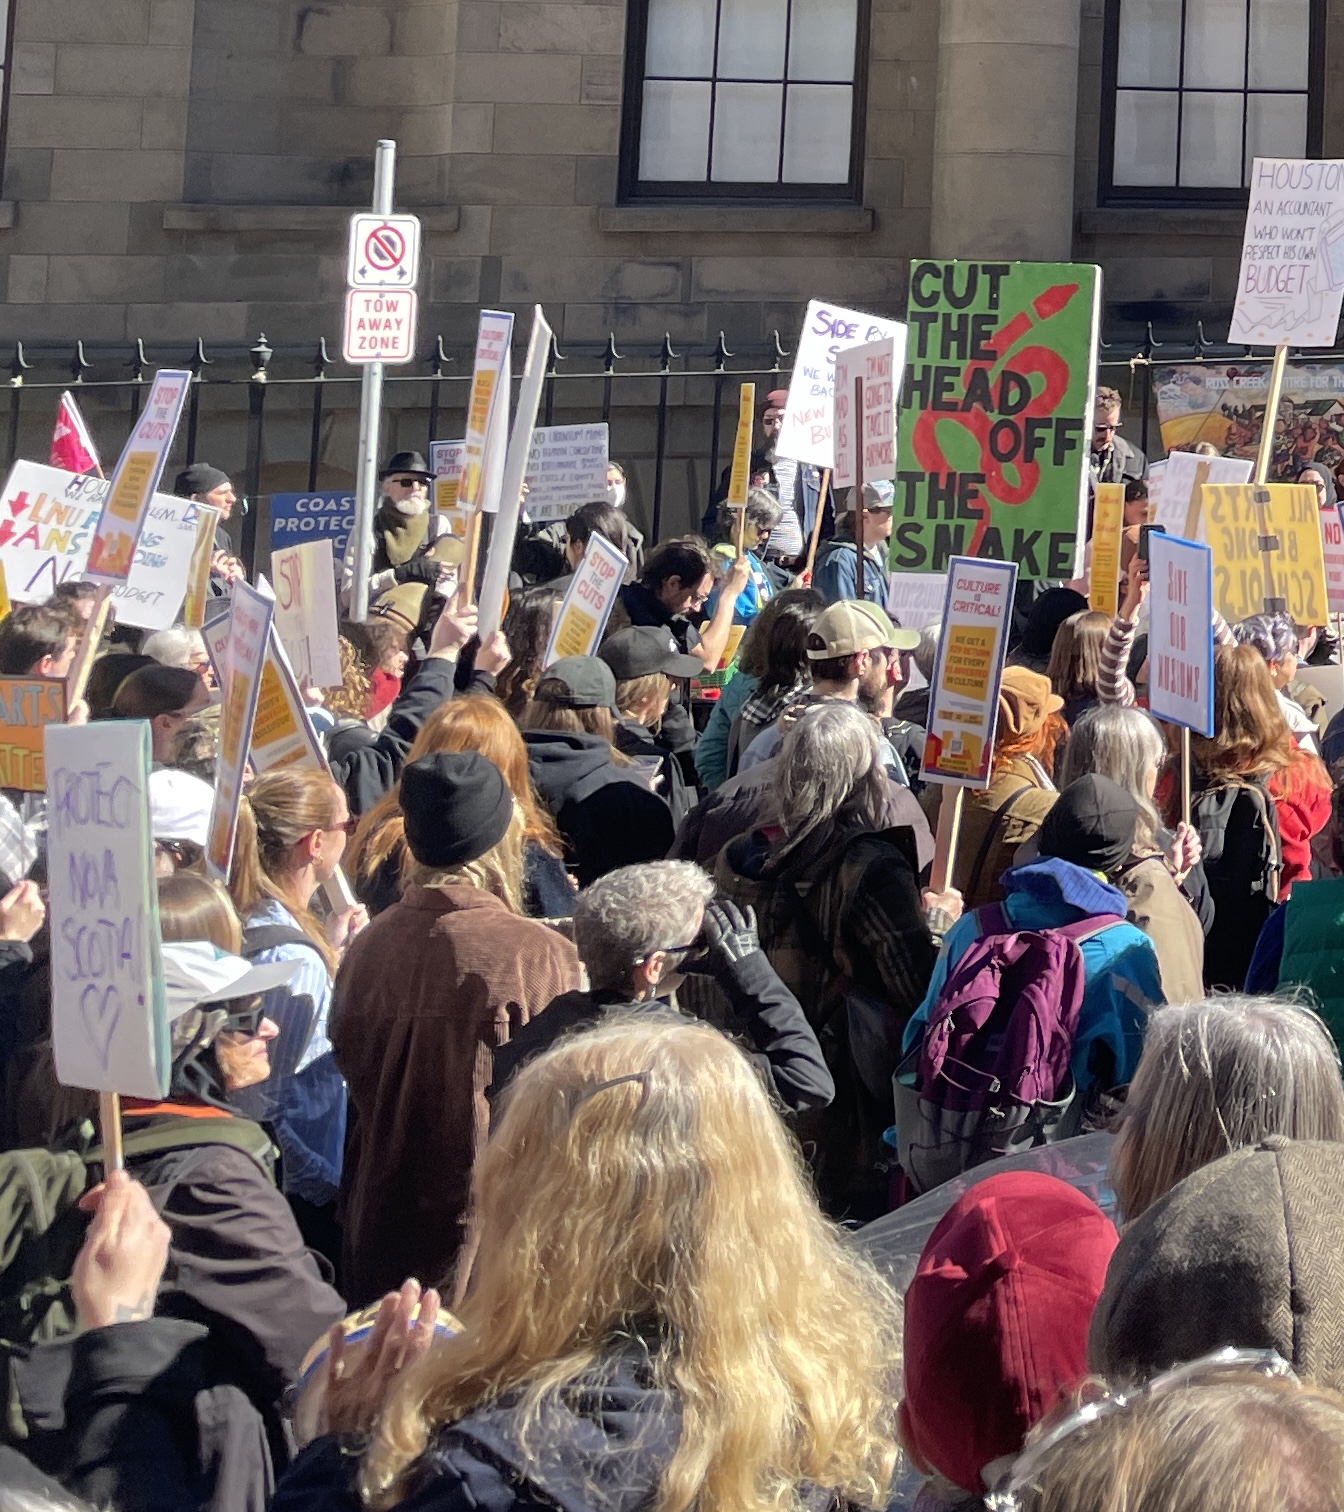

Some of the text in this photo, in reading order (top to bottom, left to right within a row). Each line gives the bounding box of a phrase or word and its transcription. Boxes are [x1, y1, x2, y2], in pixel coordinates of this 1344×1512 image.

[1253, 200, 1333, 217] AN ACCOUNTANT
[1254, 225, 1316, 241] WHO WON'T
[1244, 244, 1318, 260] RESPECT HIS OWN
[911, 262, 1010, 310] CUT
[1245, 264, 1311, 294] BUDGET
[364, 299, 399, 313] TOW
[357, 318, 404, 332] AWAY
[812, 309, 888, 342] SIDE BY
[358, 336, 400, 350] ZONE
[909, 311, 999, 361] THE
[803, 366, 821, 380] WE
[1206, 377, 1229, 388] ROSS
[1233, 376, 1266, 388] CREEK
[1310, 376, 1330, 388] FOR
[154, 387, 180, 405] STOP
[810, 384, 834, 398] BAC
[900, 364, 1031, 416] HEAD
[792, 406, 826, 426] NEW
[138, 422, 170, 440] CUTS
[989, 417, 1084, 466] OFF
[437, 449, 463, 459] STOP
[436, 465, 462, 476] CUTS
[898, 471, 986, 520] THE
[273, 515, 354, 532] PROTEC
[1324, 522, 1341, 545] NO
[895, 522, 1078, 580] SNAKE
[589, 551, 615, 579] STOP
[589, 571, 604, 590] THE
[956, 578, 1002, 595] CULTURE
[577, 579, 606, 610] CUTS
[952, 599, 1002, 617] CRITICAL!
